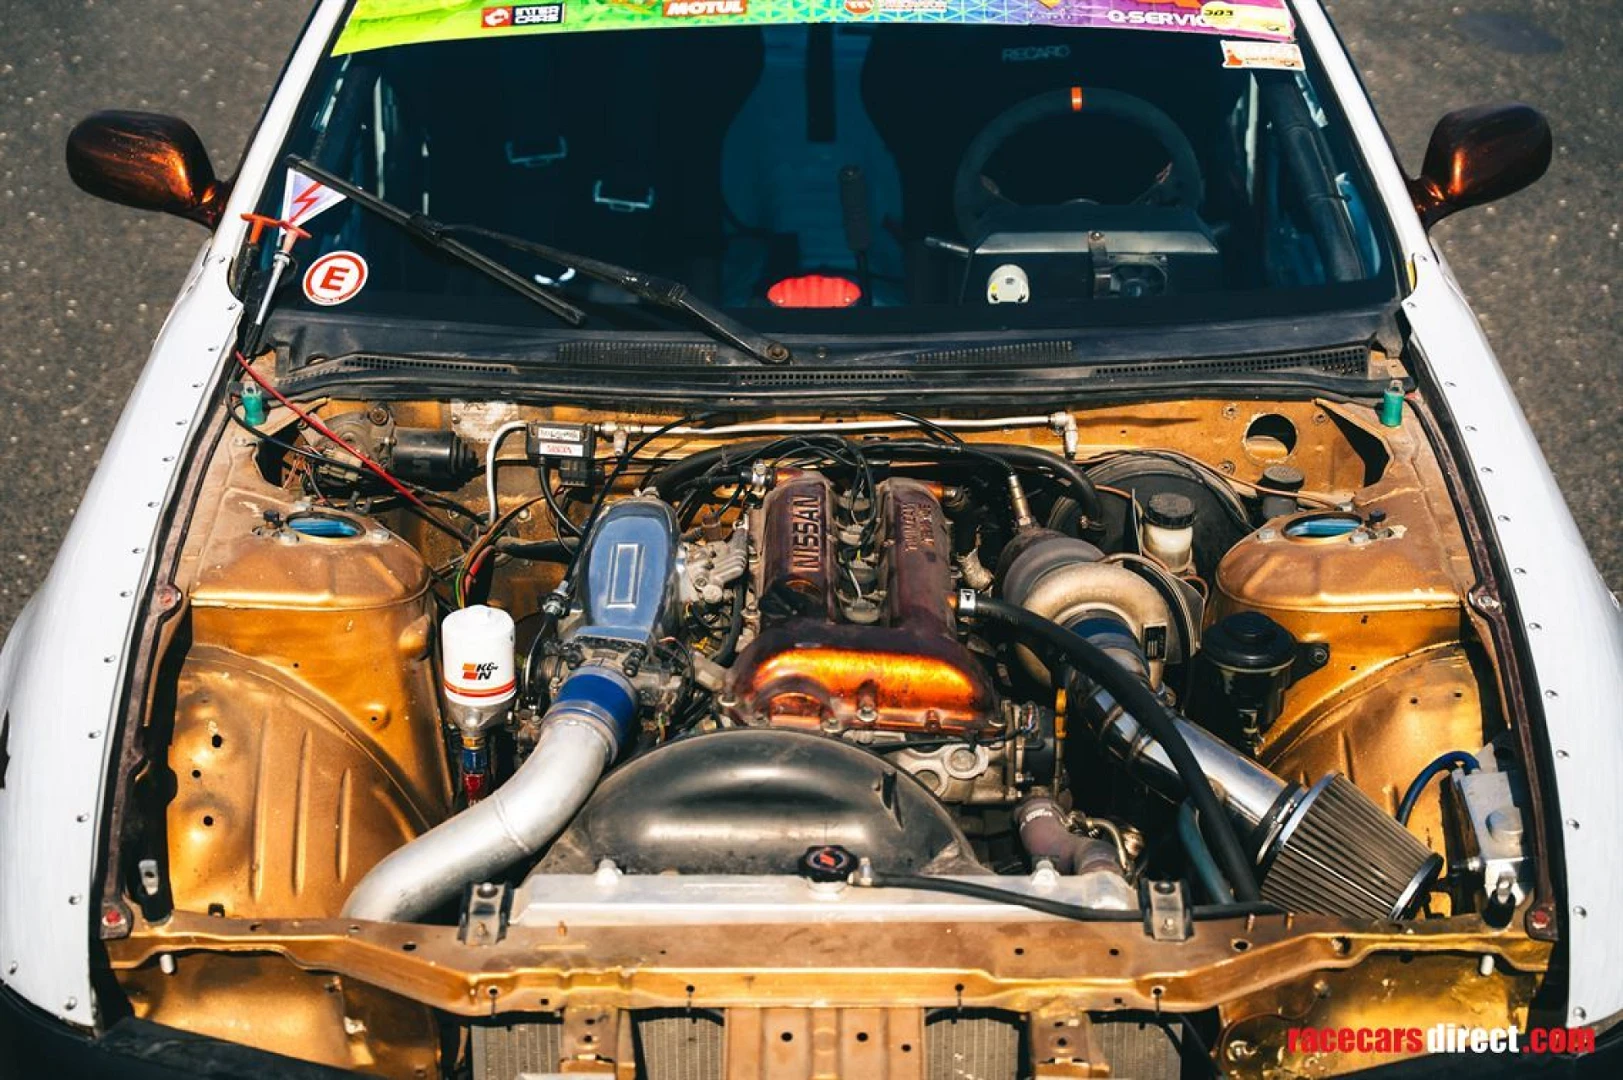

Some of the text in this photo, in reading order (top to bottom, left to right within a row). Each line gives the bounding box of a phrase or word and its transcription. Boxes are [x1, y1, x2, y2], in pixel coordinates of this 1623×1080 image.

[514, 5, 560, 17] INTER
[667, 0, 744, 15] MOTUL
[514, 14, 559, 24] CARS
[1002, 44, 1070, 62] RECARO
[319, 265, 350, 291] E
[792, 495, 821, 573] NISSAN
